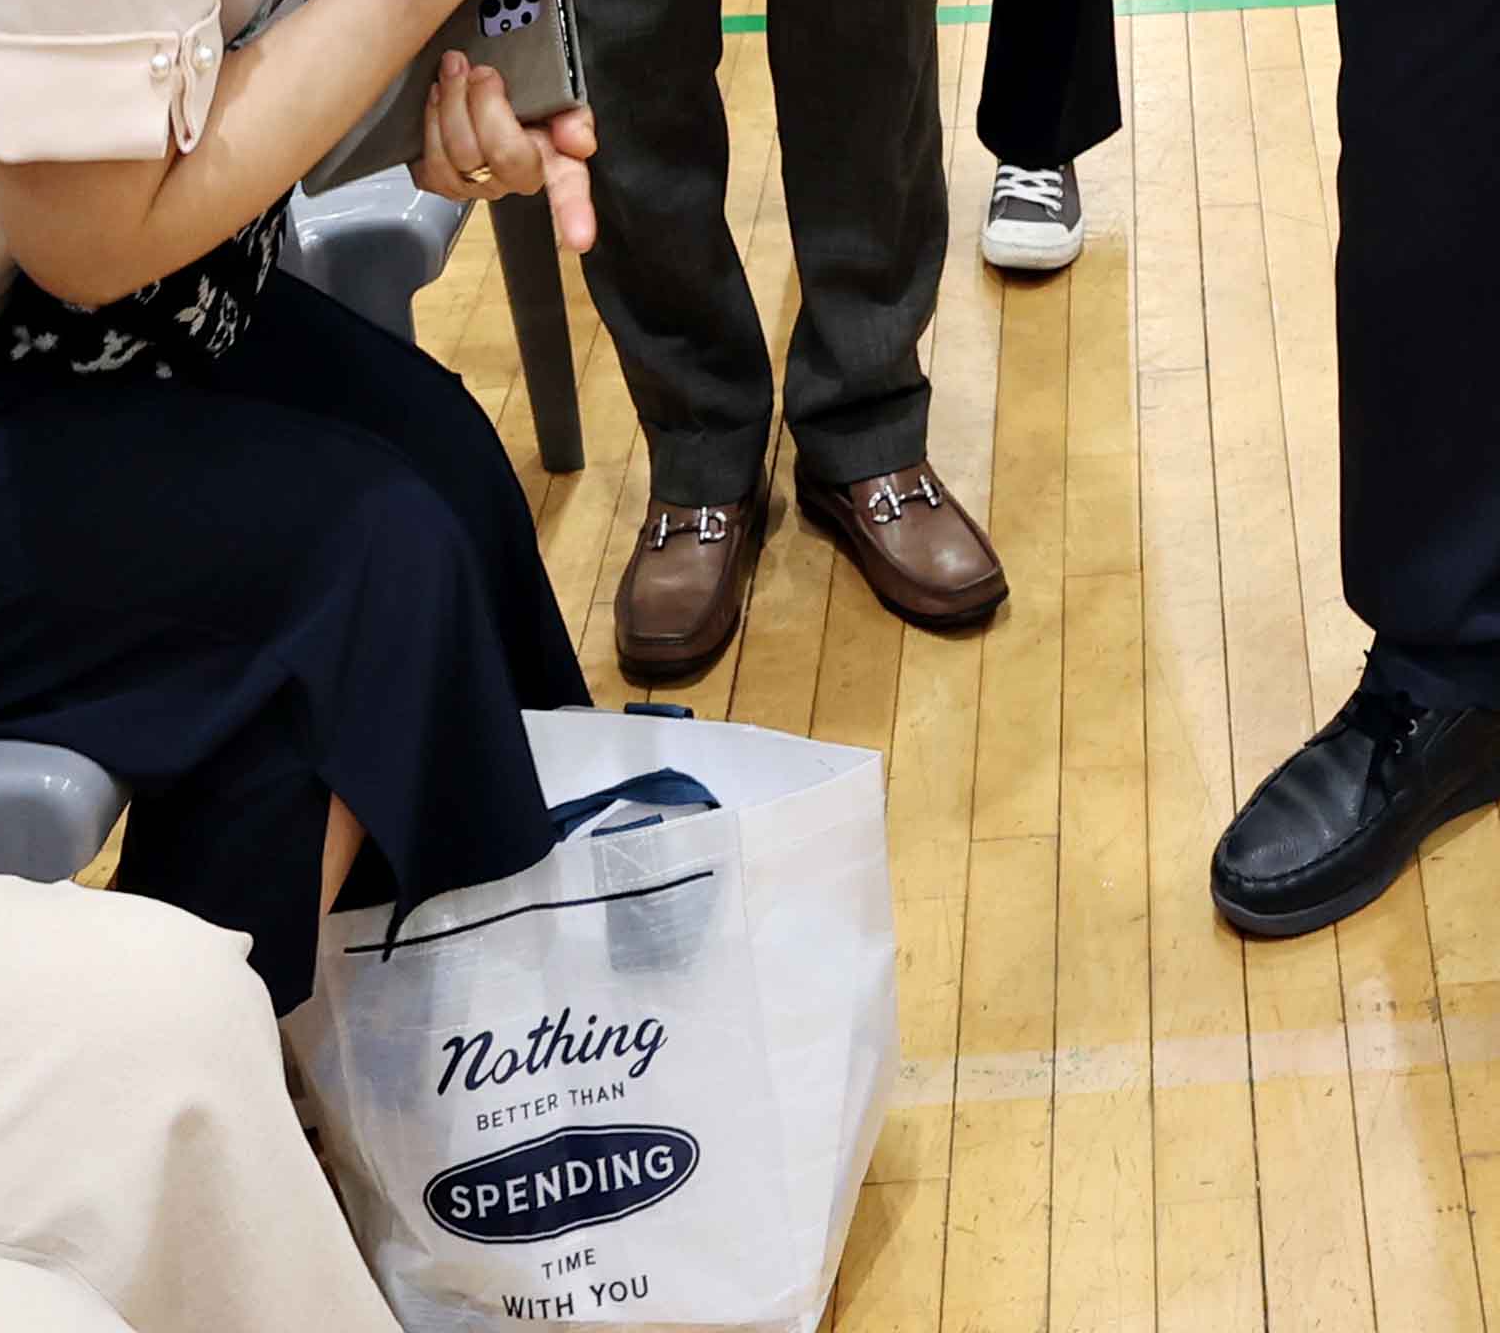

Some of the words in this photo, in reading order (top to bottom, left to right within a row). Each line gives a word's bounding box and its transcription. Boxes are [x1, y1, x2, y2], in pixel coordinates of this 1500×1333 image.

[437, 1006, 668, 1097] Nothing
[476, 1093, 559, 1132] BETTER
[567, 1081, 626, 1107] THAN
[450, 1144, 676, 1220] SPENDING
[540, 1247, 598, 1281] TIME
[502, 1292, 576, 1321] WITH
[589, 1274, 649, 1308] YOU
